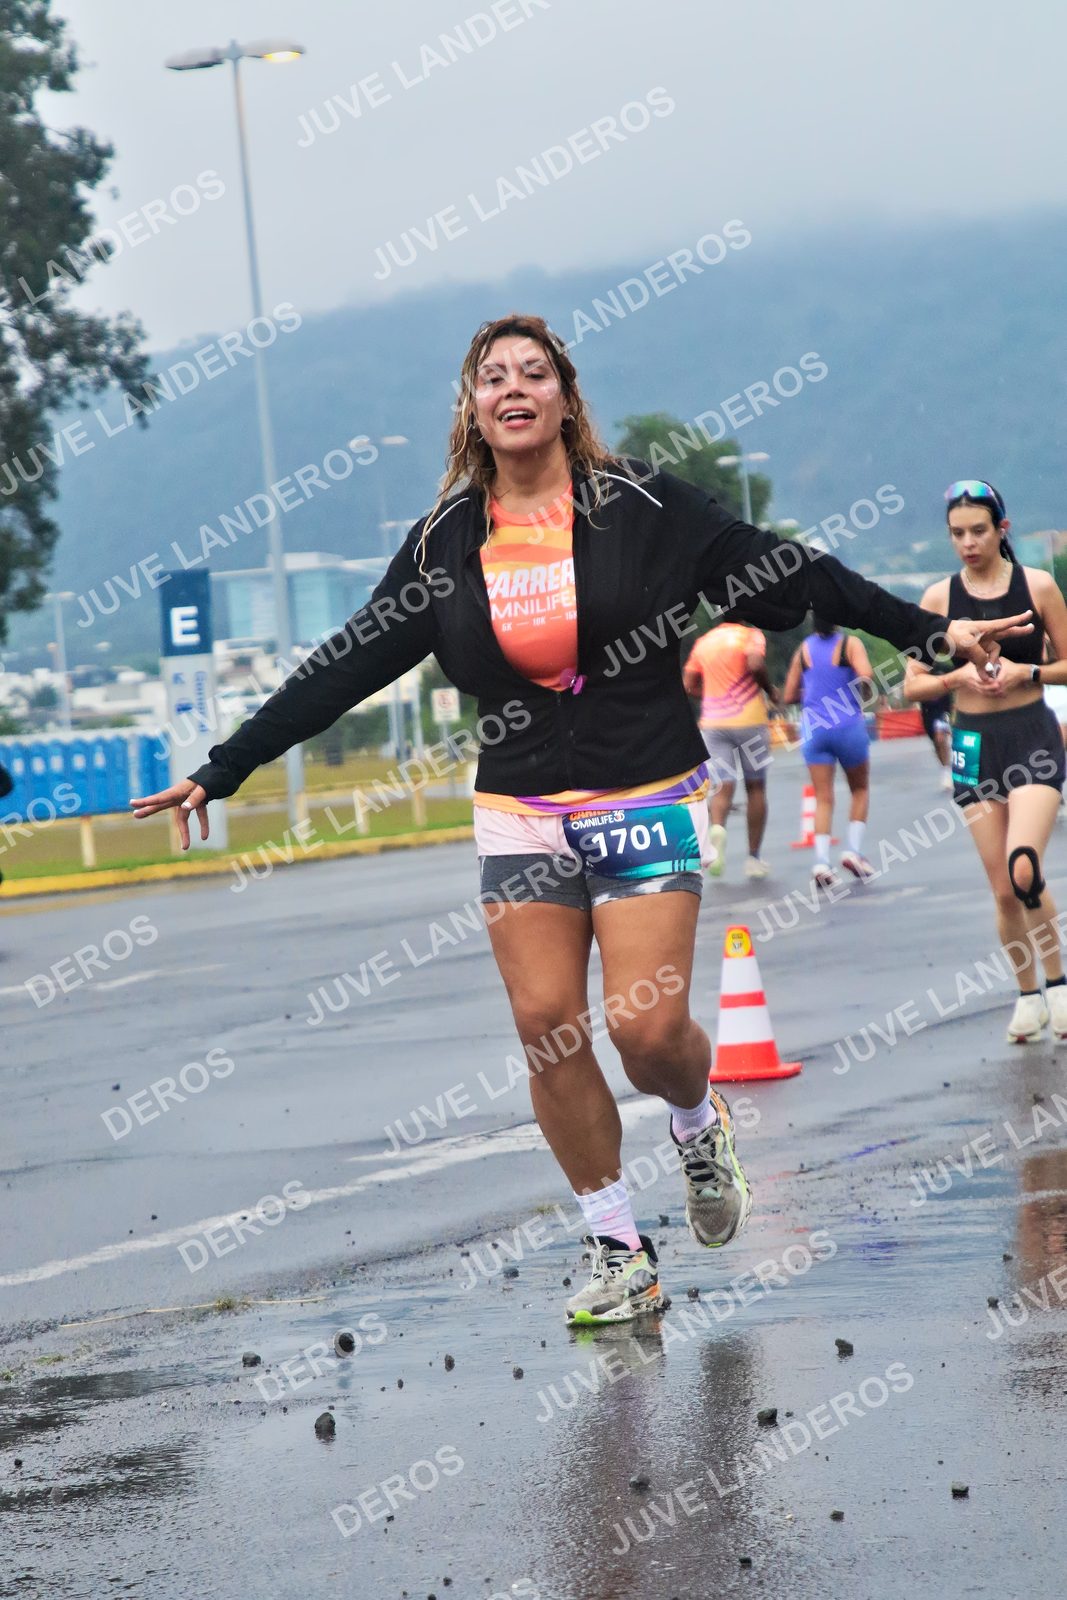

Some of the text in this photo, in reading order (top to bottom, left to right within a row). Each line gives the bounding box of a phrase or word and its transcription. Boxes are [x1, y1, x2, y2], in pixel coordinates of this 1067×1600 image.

[170, 605, 200, 647] E
[571, 814, 614, 830] OMNILIFE
[591, 821, 668, 857] 1701
